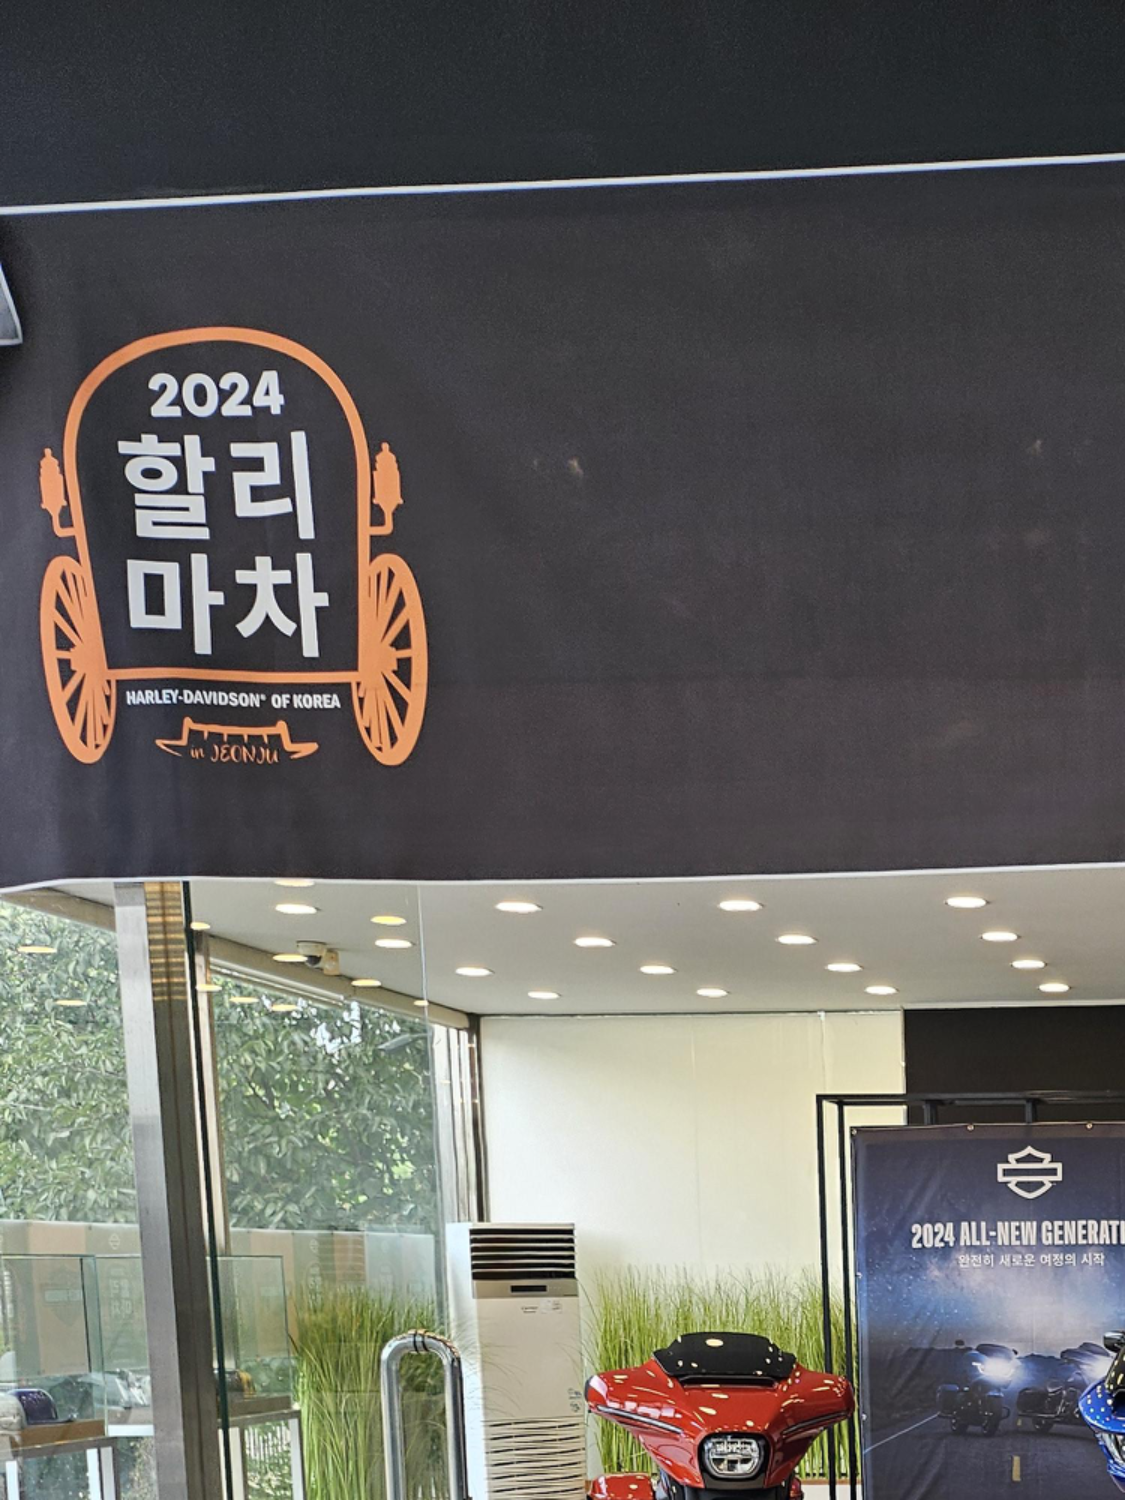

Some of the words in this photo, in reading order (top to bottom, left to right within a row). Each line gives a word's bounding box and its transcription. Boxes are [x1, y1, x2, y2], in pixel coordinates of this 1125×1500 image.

[148, 370, 285, 417] 2024
[117, 430, 315, 539] 할리
[127, 553, 329, 657] 마차
[271, 694, 290, 709] OF
[293, 693, 341, 709] KOREA
[190, 745, 205, 759] in
[911, 1222, 955, 1249] 2024
[960, 1221, 1036, 1247] ALL-NEW
[958, 1254, 994, 1268] 완전히
[999, 1254, 1036, 1267] 새로운
[1040, 1253, 1076, 1267] 여정의
[1081, 1252, 1105, 1267] 시작
